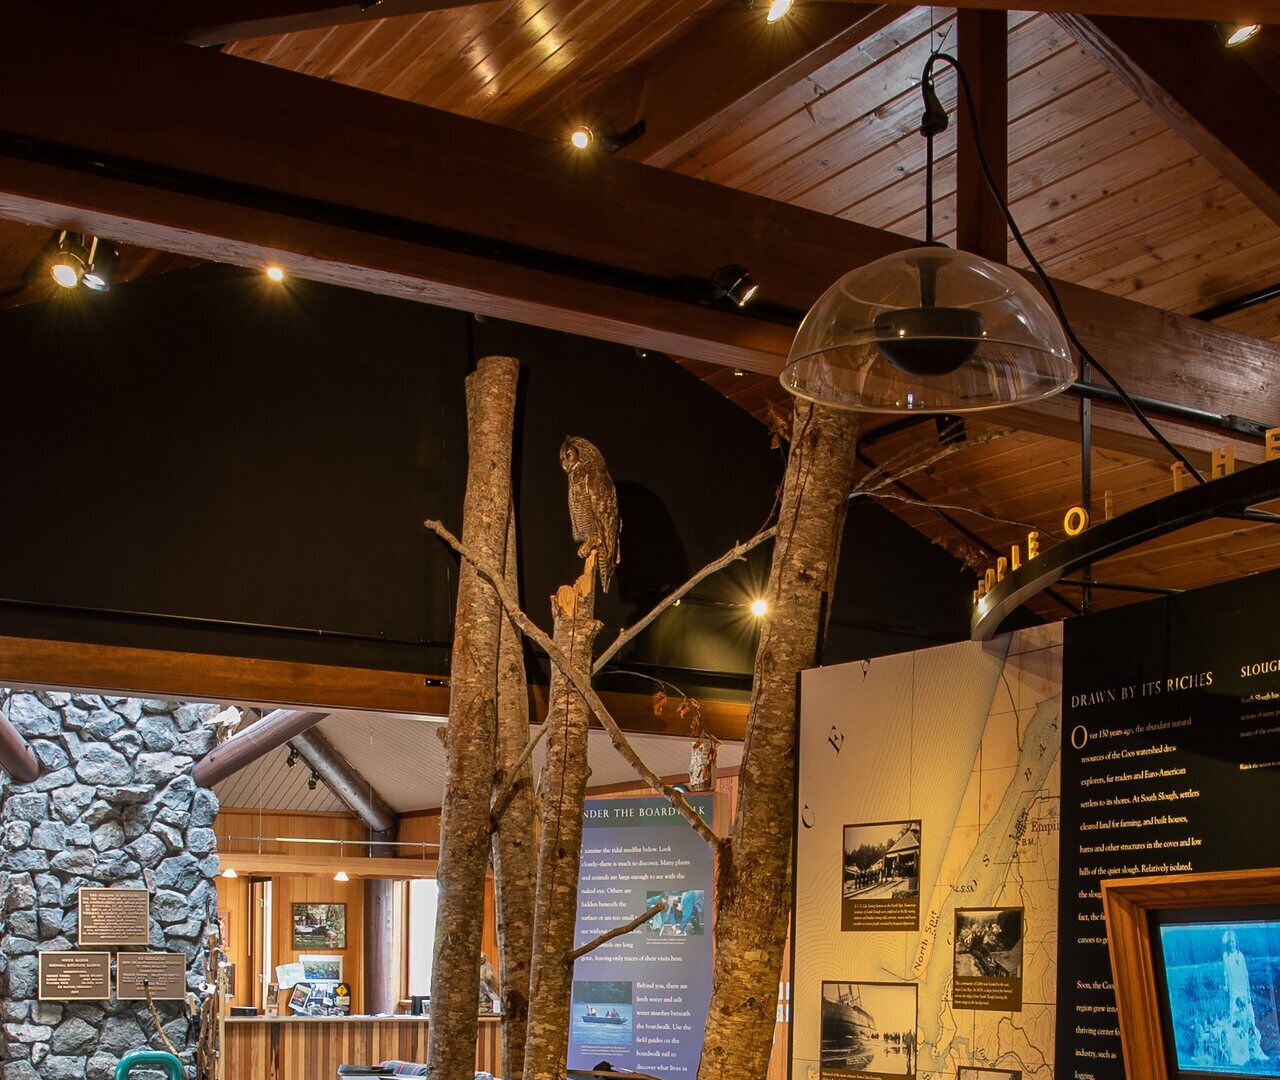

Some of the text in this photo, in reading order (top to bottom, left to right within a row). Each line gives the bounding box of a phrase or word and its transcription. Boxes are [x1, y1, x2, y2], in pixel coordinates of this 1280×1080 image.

[1072, 672, 1213, 708] DRAWN BY ITS RICHES
[584, 808, 609, 819] NDER
[614, 808, 634, 818] THE
[914, 910, 937, 971] North Spit
